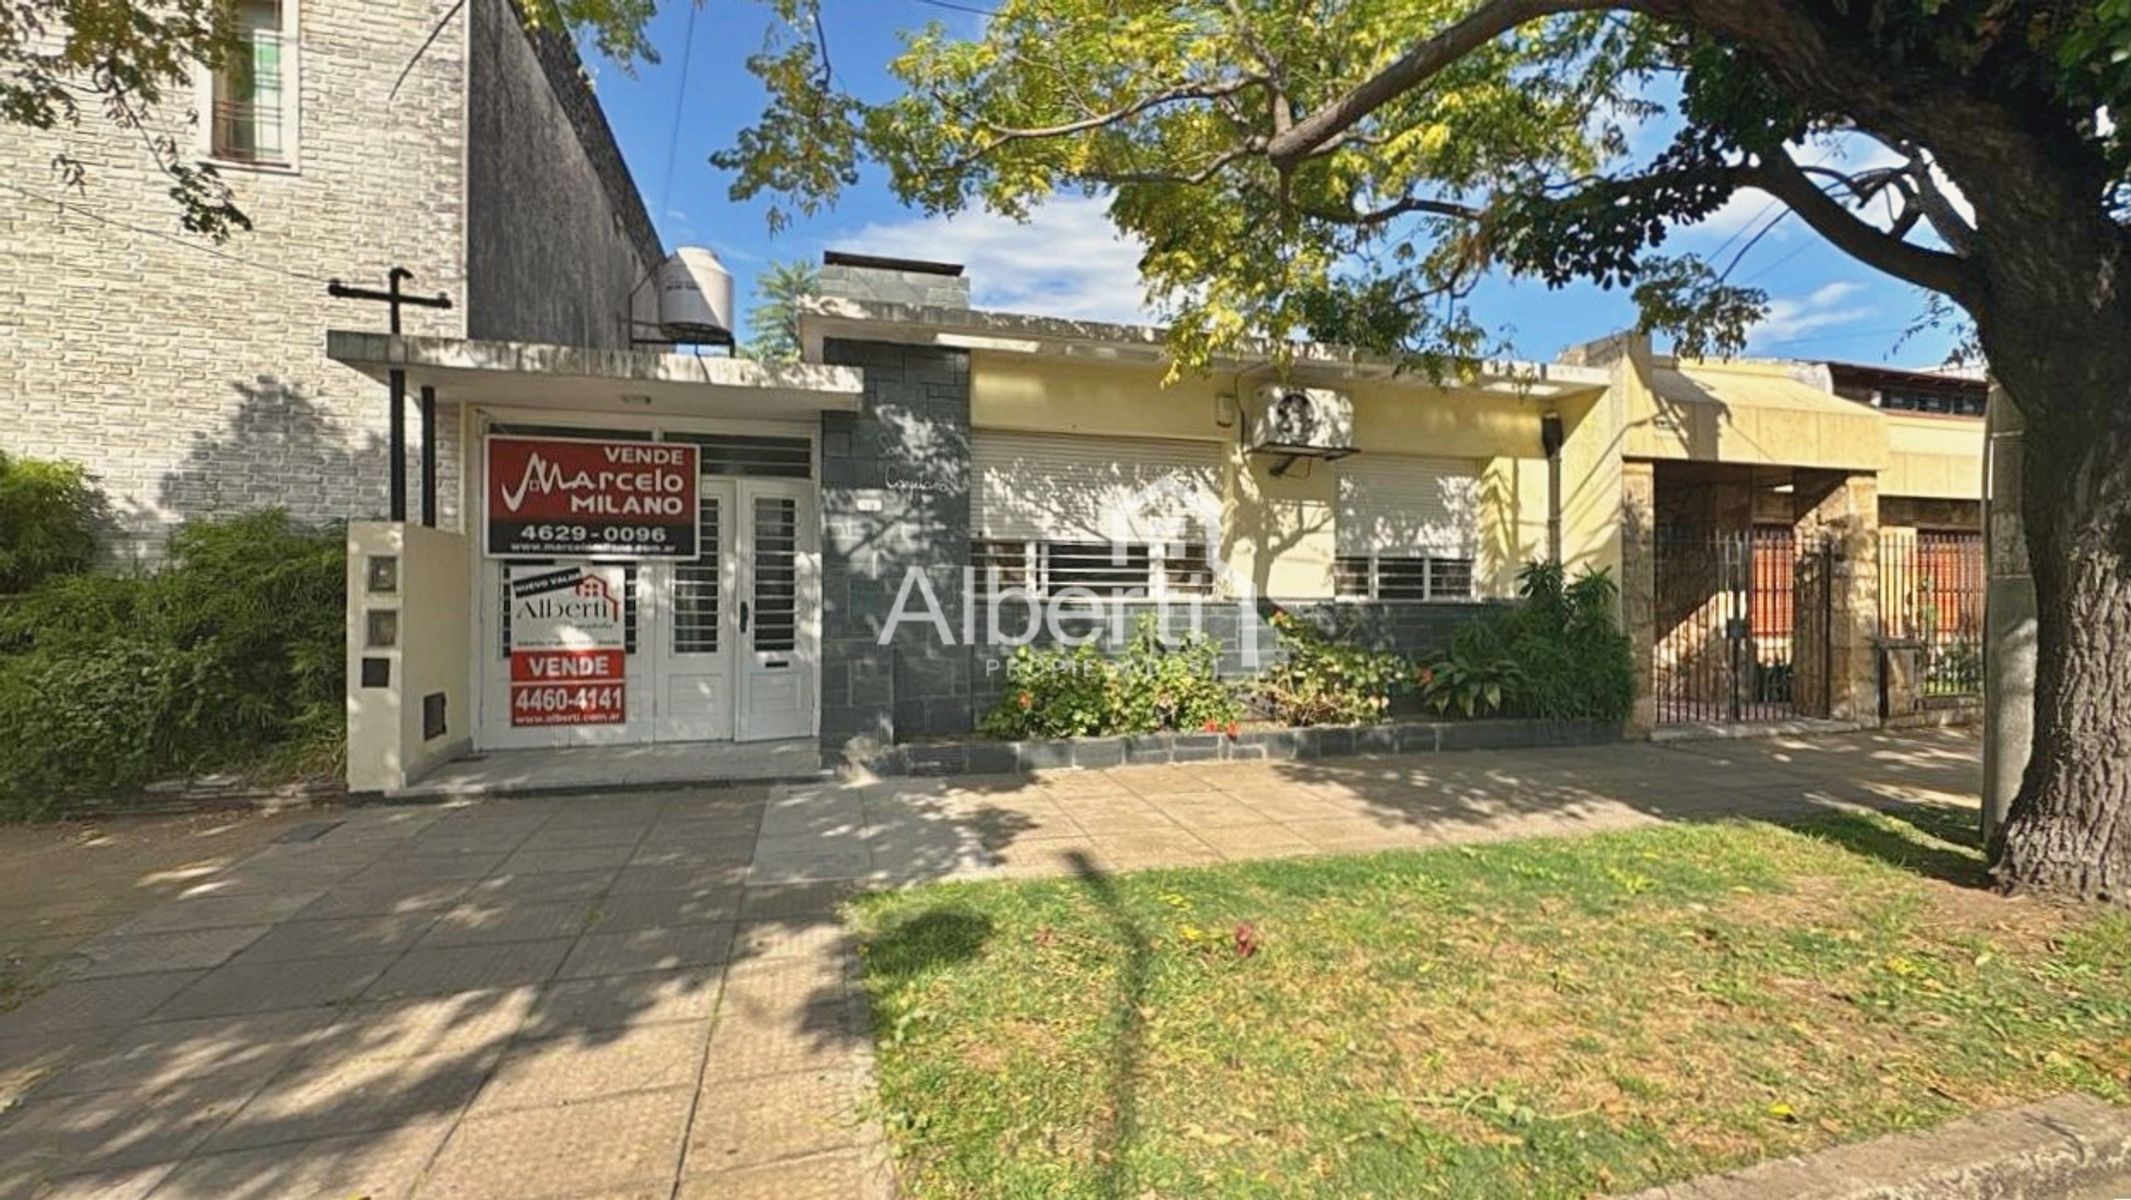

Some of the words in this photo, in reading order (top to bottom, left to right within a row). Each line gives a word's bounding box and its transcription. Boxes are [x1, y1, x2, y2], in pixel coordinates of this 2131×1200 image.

[604, 447, 684, 465] VENDE
[571, 495, 683, 515] MILANO
[517, 598, 607, 619] Alberti
[528, 656, 609, 676] VENDE
[515, 687, 622, 711] 4460-4141
